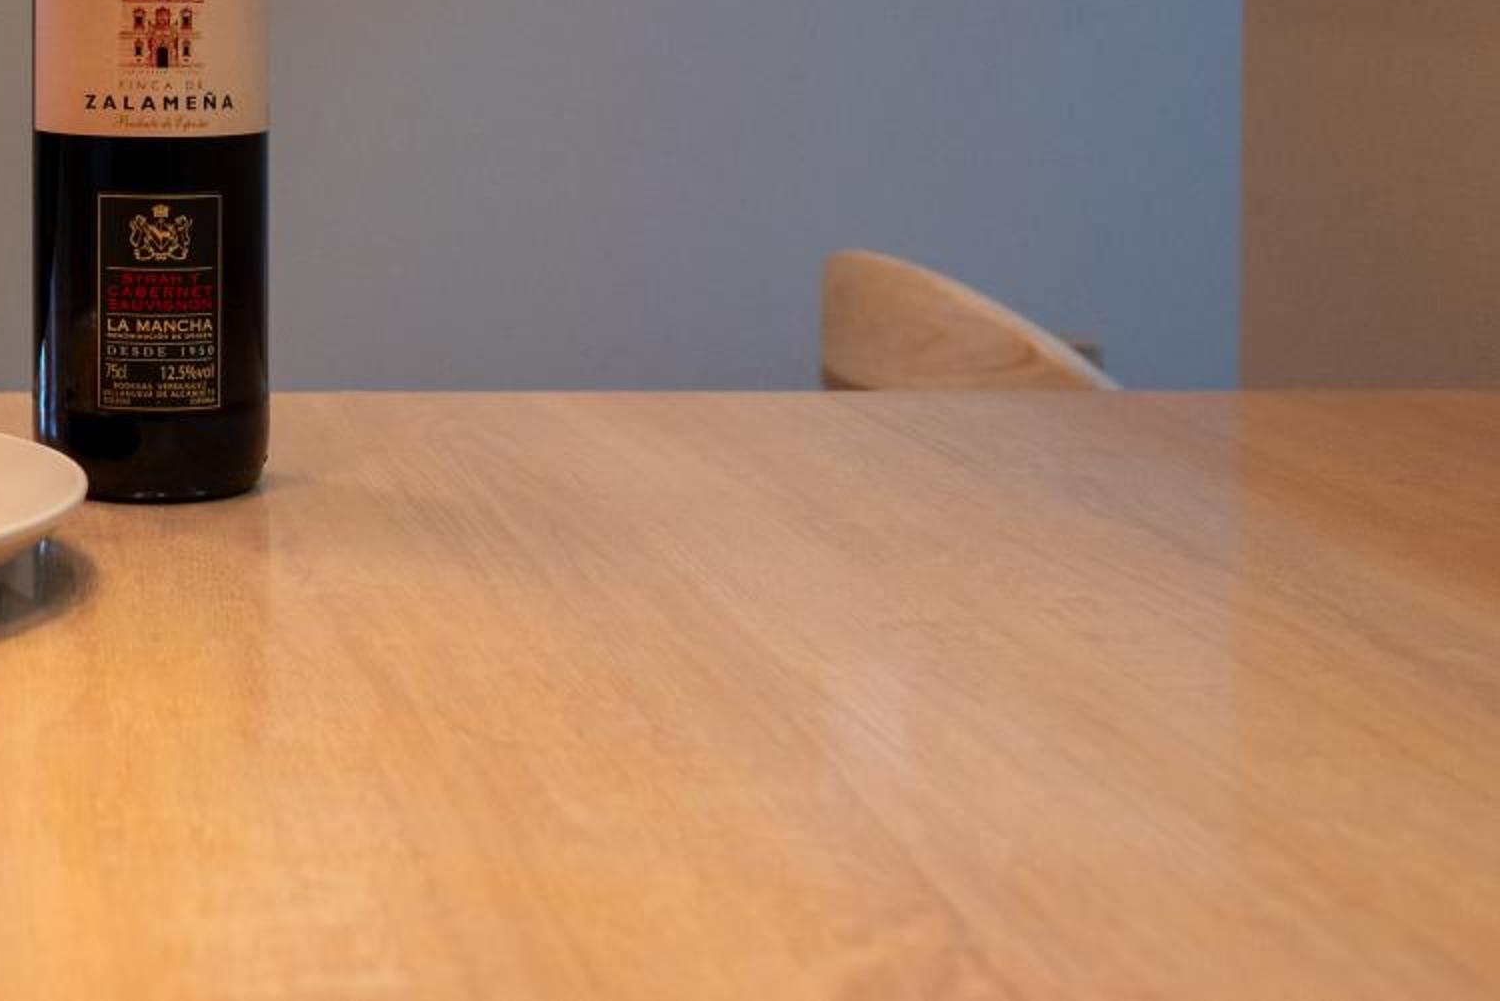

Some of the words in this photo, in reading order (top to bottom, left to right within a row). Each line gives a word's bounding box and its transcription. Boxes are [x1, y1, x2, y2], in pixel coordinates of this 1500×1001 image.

[118, 80, 173, 90] FINCA
[185, 80, 203, 90] DE
[85, 92, 234, 111] ZALAMEÑA
[107, 285, 213, 297] CABERNET
[107, 298, 213, 311] SAUVIGNON
[107, 318, 129, 332] LA
[136, 318, 213, 333] MANCHA
[107, 344, 167, 357] DESDE
[105, 362, 128, 379] 75cl
